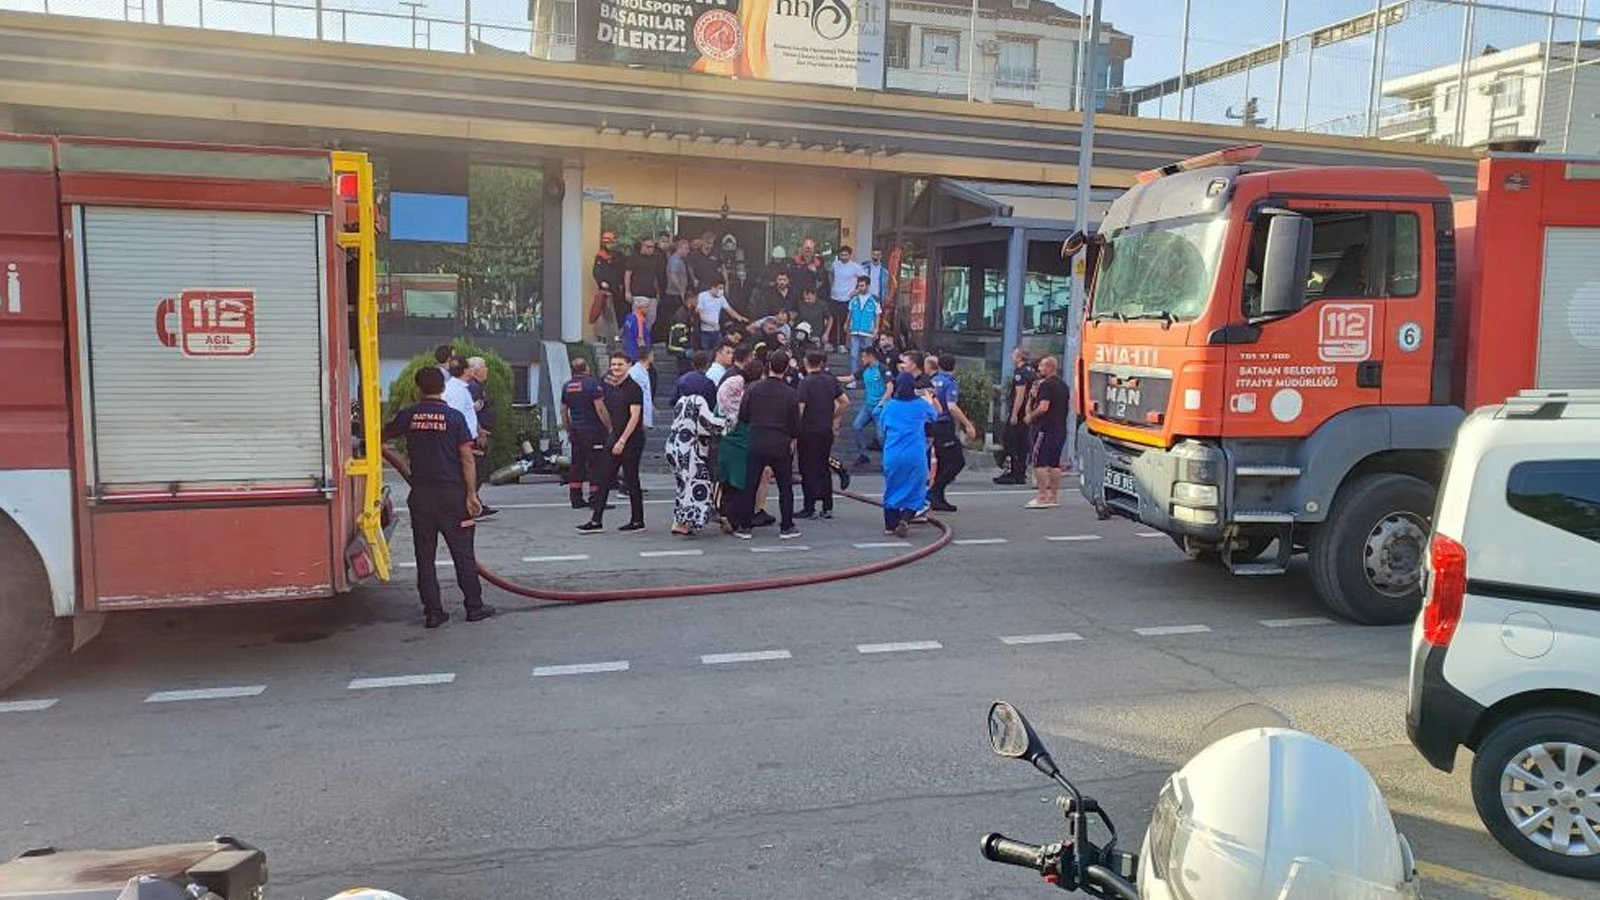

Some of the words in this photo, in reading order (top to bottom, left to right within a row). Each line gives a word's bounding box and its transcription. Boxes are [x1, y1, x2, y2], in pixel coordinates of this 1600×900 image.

[600, 3, 686, 31] BAŞARILAR
[608, 0, 693, 16] ROLSPOR'A
[188, 299, 246, 328] 112
[1327, 312, 1366, 337] 112
[1404, 327, 1415, 346] 6
[1239, 366, 1281, 375] BATMAN
[1107, 386, 1140, 405] MAN
[412, 413, 445, 421] BATMAN
